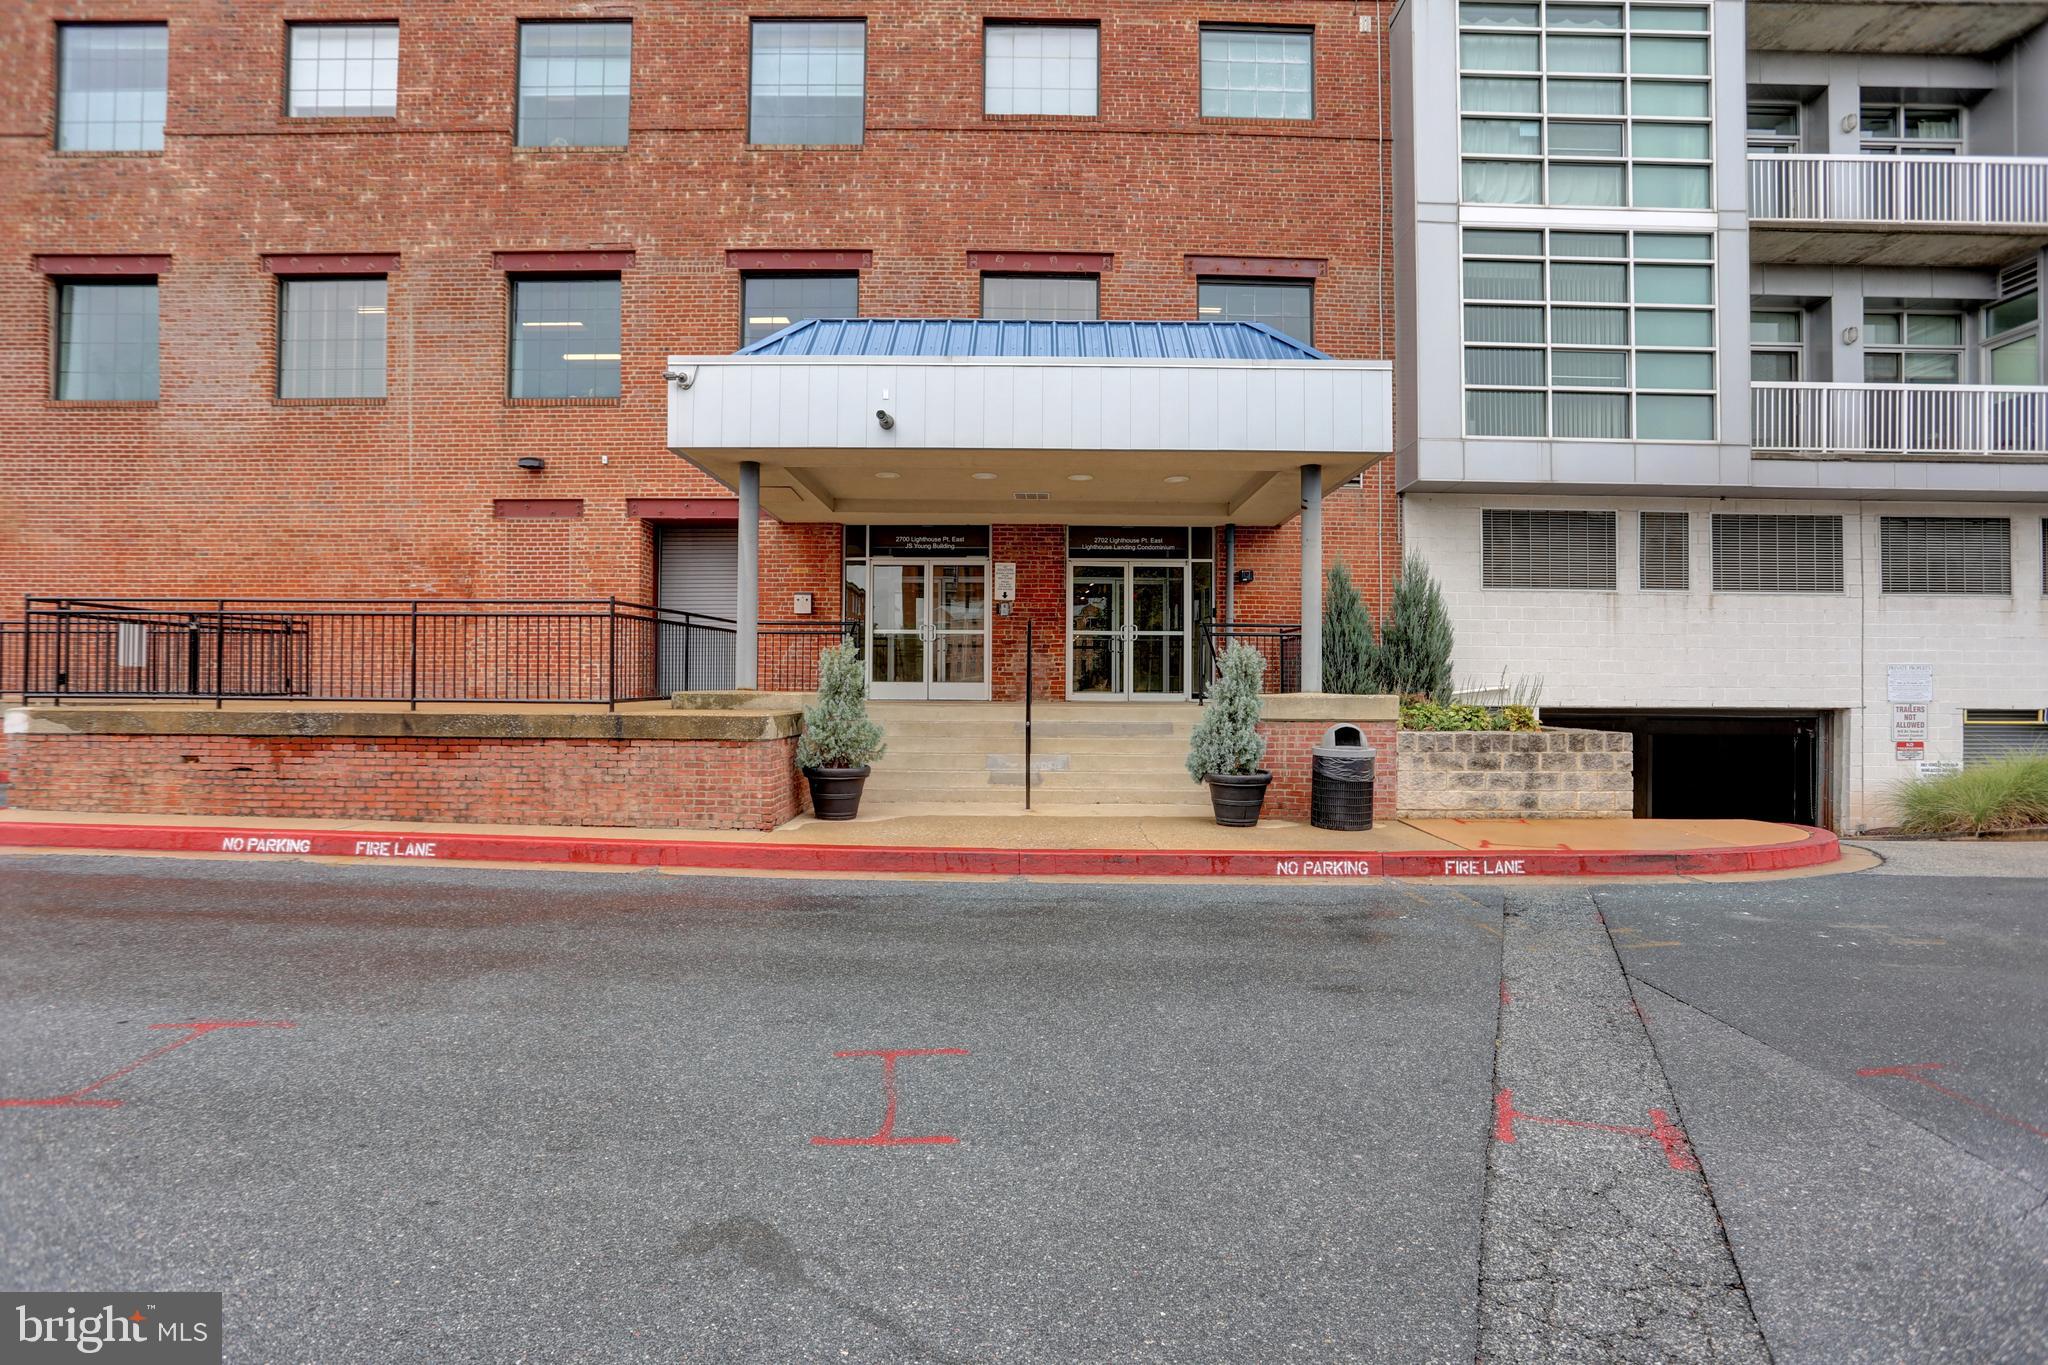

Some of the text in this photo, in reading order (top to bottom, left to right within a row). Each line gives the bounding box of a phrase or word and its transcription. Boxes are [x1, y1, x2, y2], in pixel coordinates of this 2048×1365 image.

[223, 838, 311, 852] NO PARKING
[356, 841, 436, 856] FIRE LANE
[1277, 861, 1368, 875] NO PARKING
[1445, 860, 1525, 874] FIRE LANE
